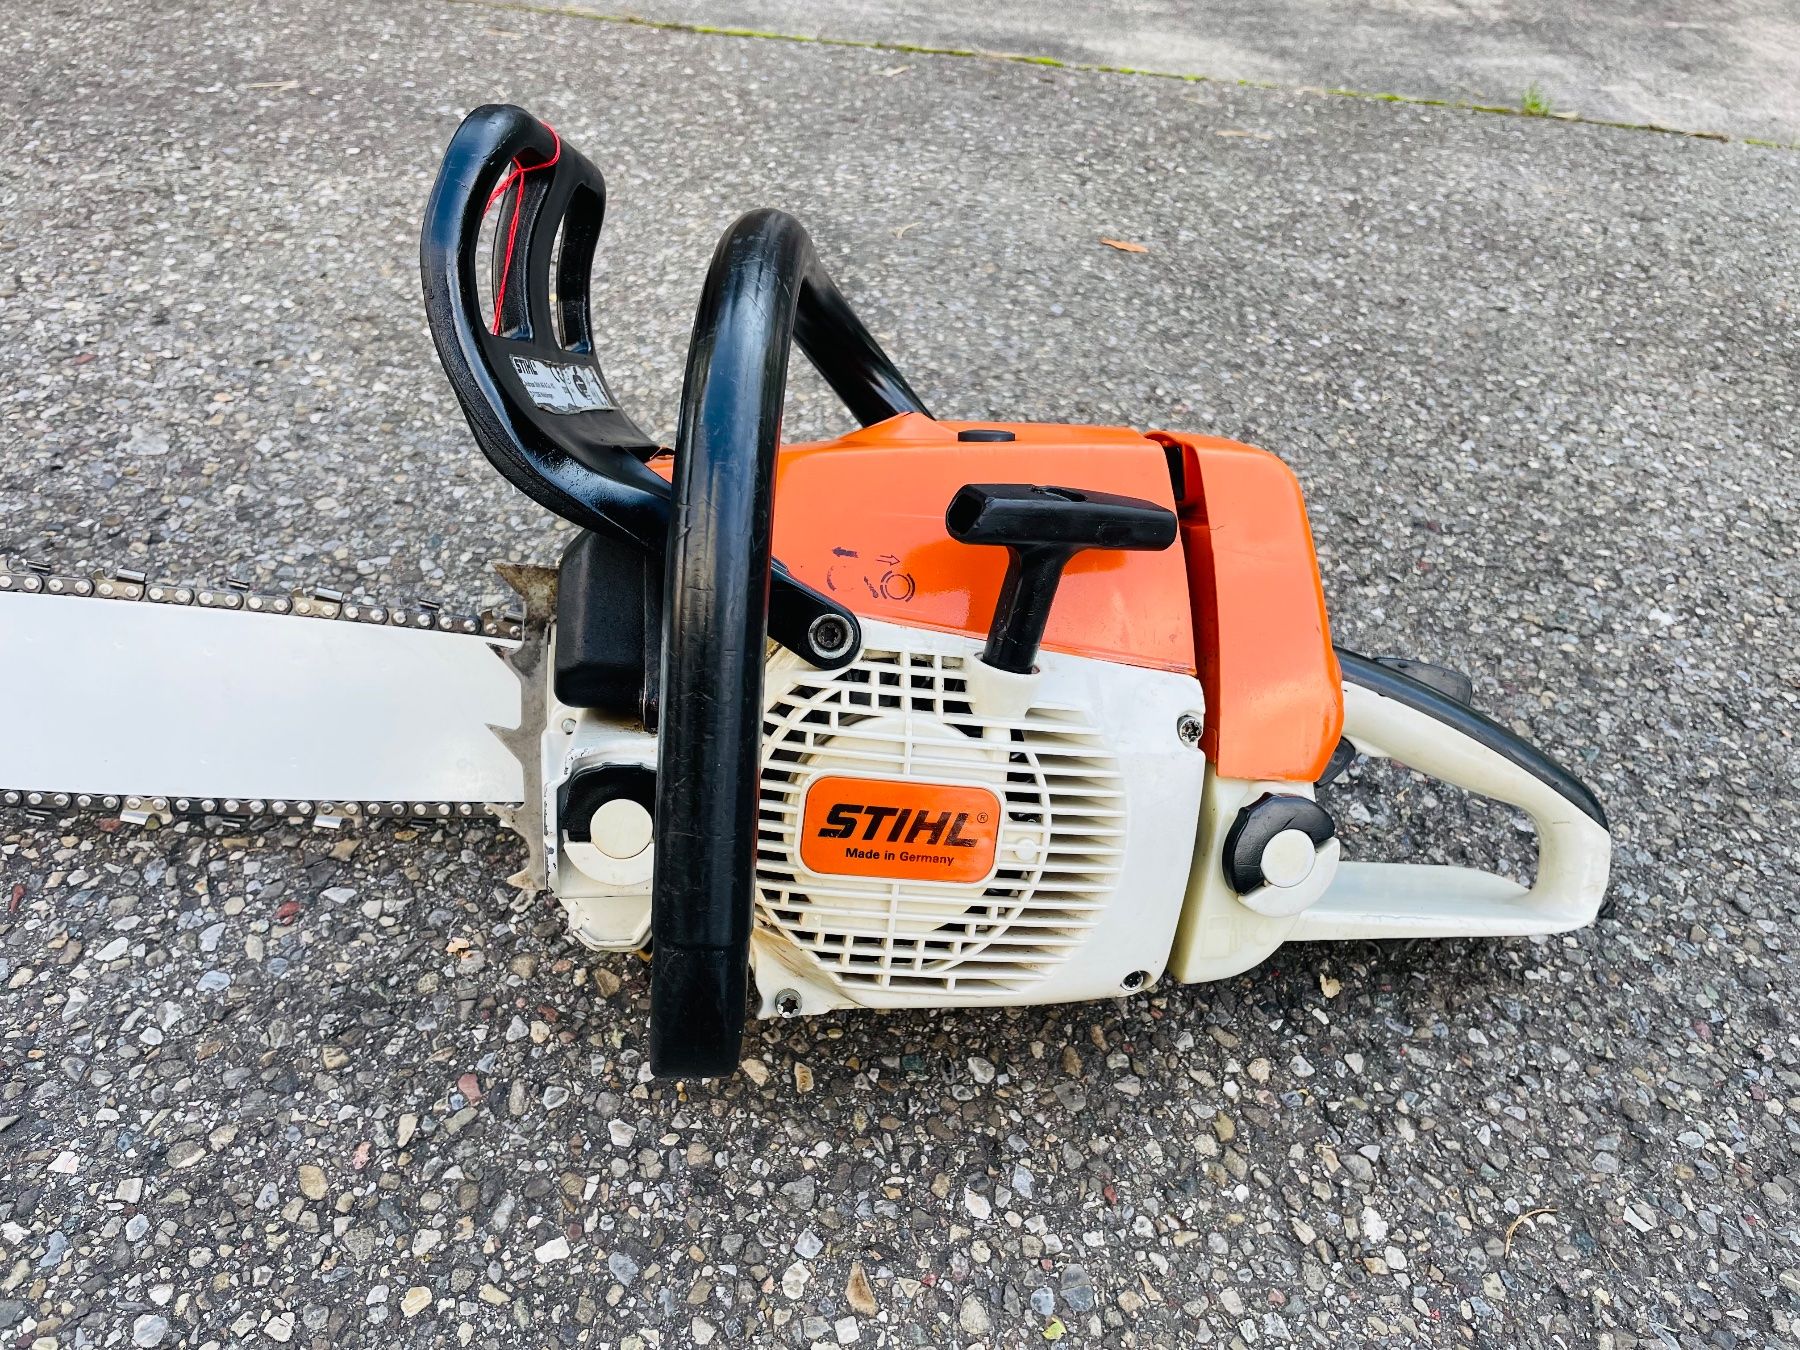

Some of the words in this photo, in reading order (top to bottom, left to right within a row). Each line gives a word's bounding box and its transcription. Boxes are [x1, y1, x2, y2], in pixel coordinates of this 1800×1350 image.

[513, 358, 538, 375] STIHL
[845, 848, 880, 860] Made
[884, 850, 895, 861] in
[899, 851, 955, 867] Germany
